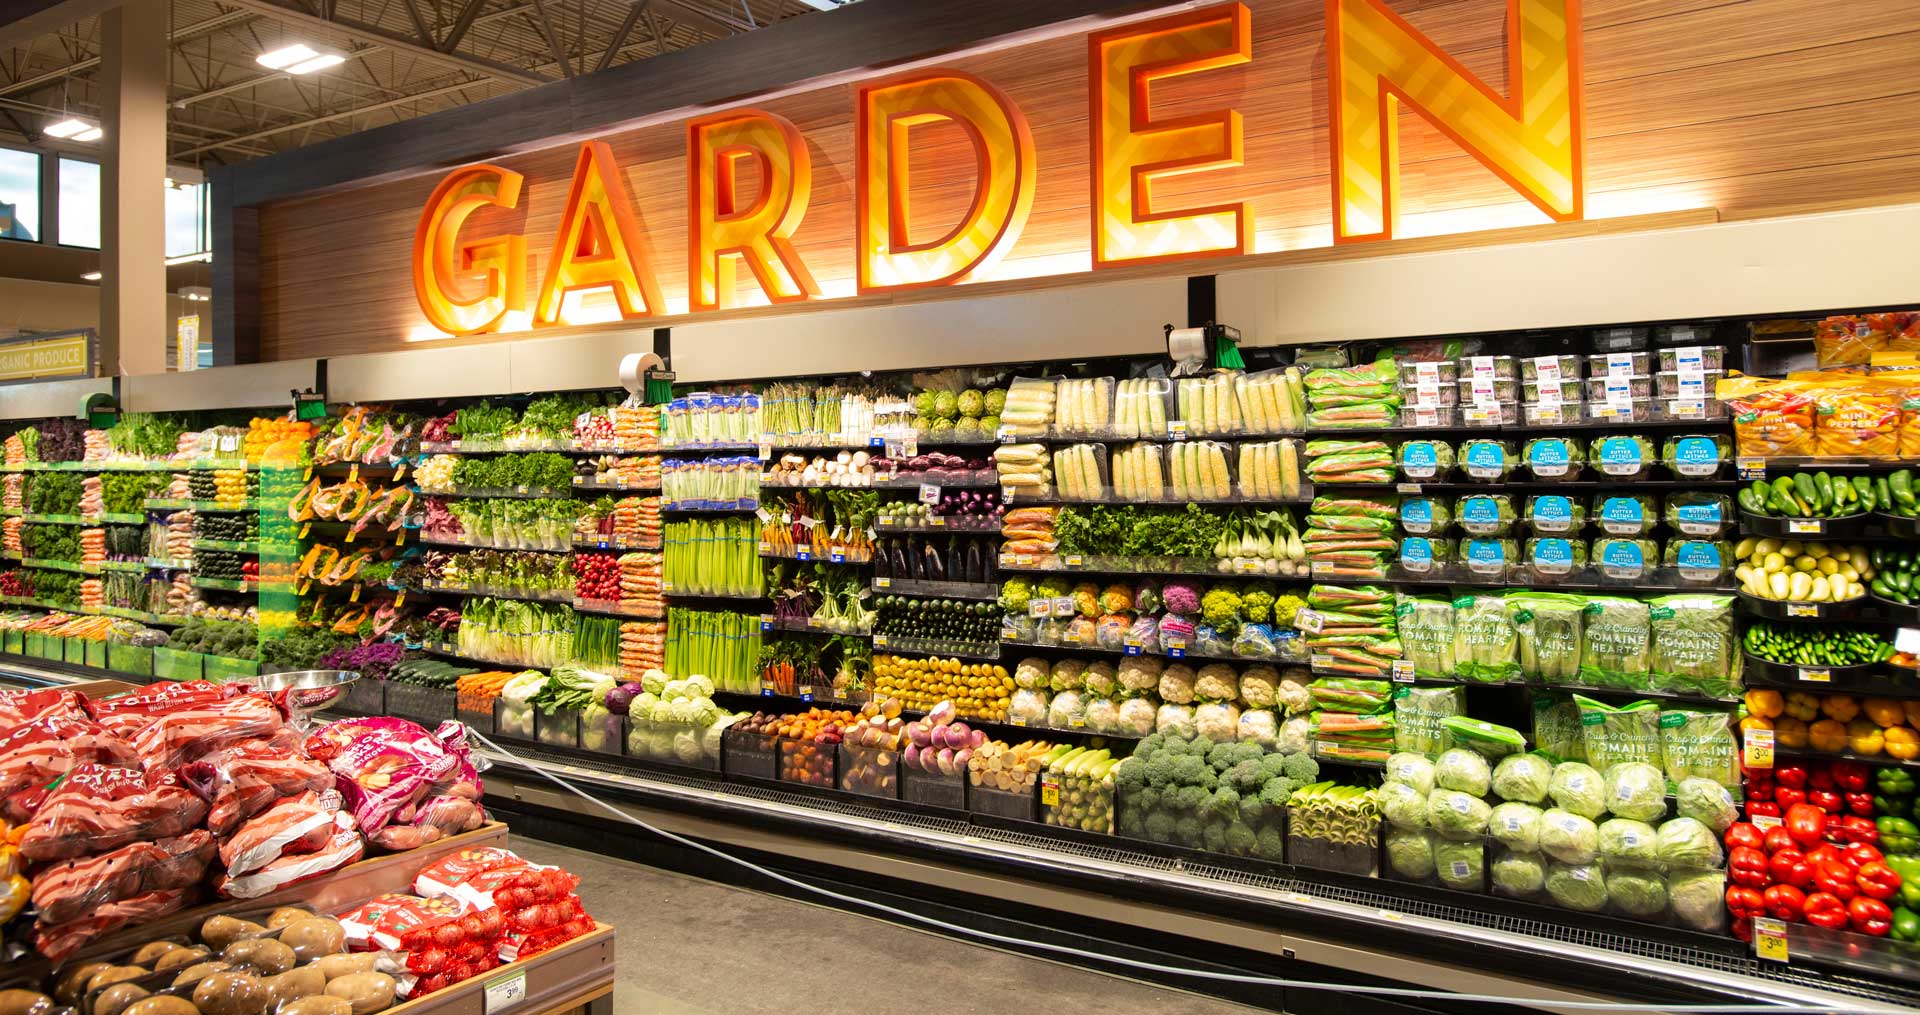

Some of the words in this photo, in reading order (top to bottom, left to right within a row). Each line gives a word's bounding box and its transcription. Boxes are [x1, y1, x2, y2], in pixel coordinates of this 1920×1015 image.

[413, 0, 1586, 337] GARDEN
[33, 347, 80, 368] PRODUCE
[1459, 624, 1513, 637] ROMAINE
[1587, 629, 1646, 645] ROMAINE
[1464, 635, 1506, 647] HEARTS
[1591, 641, 1640, 656] HEARTS
[1590, 742, 1656, 754] ROMAINE
